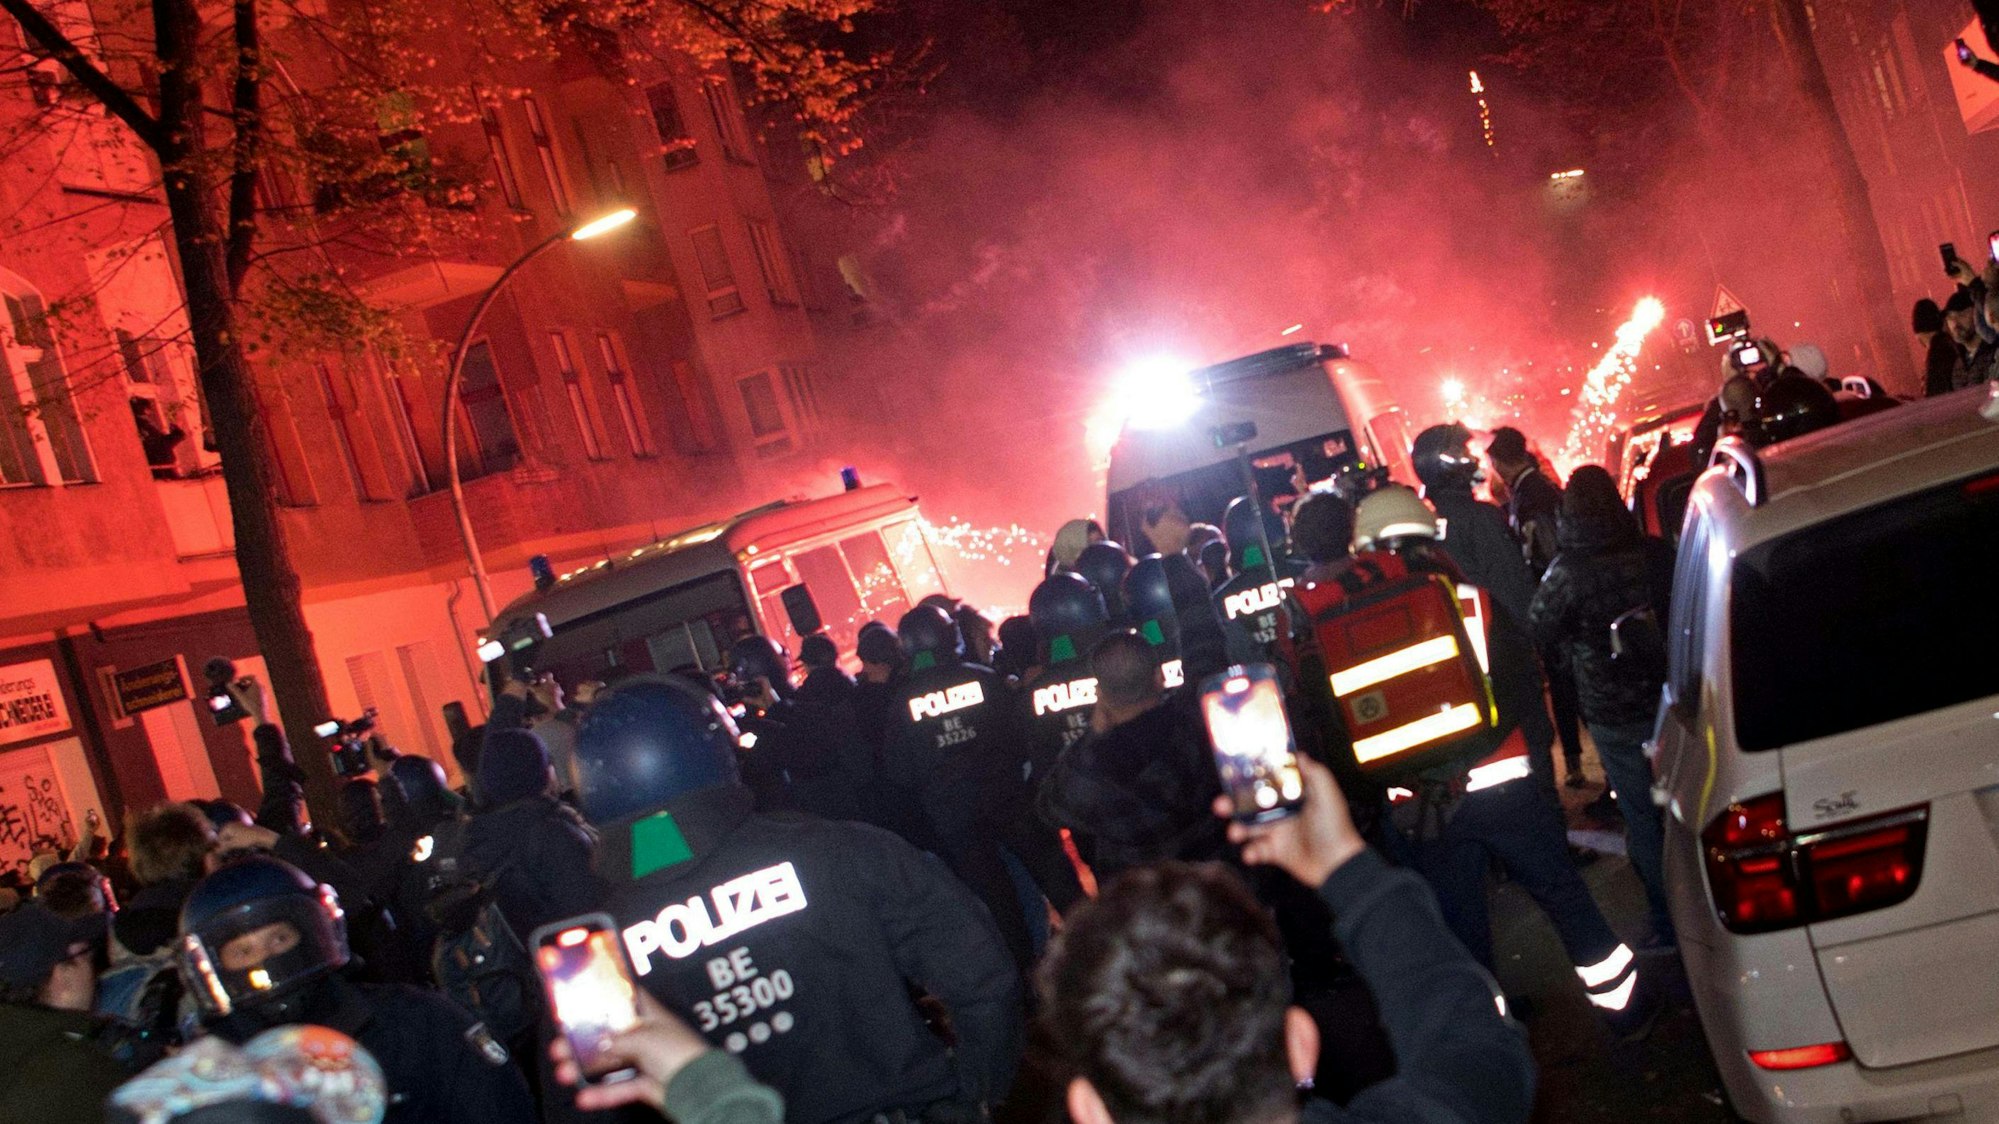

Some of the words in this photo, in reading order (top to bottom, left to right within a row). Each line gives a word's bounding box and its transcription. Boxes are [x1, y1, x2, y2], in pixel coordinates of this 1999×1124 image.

[908, 680, 985, 722] POLIZEI
[1033, 677, 1099, 716] POLIZE
[943, 716, 962, 732] BE
[622, 860, 808, 977] POLIZEI
[705, 946, 759, 992] BE
[692, 968, 795, 1033] 35300
